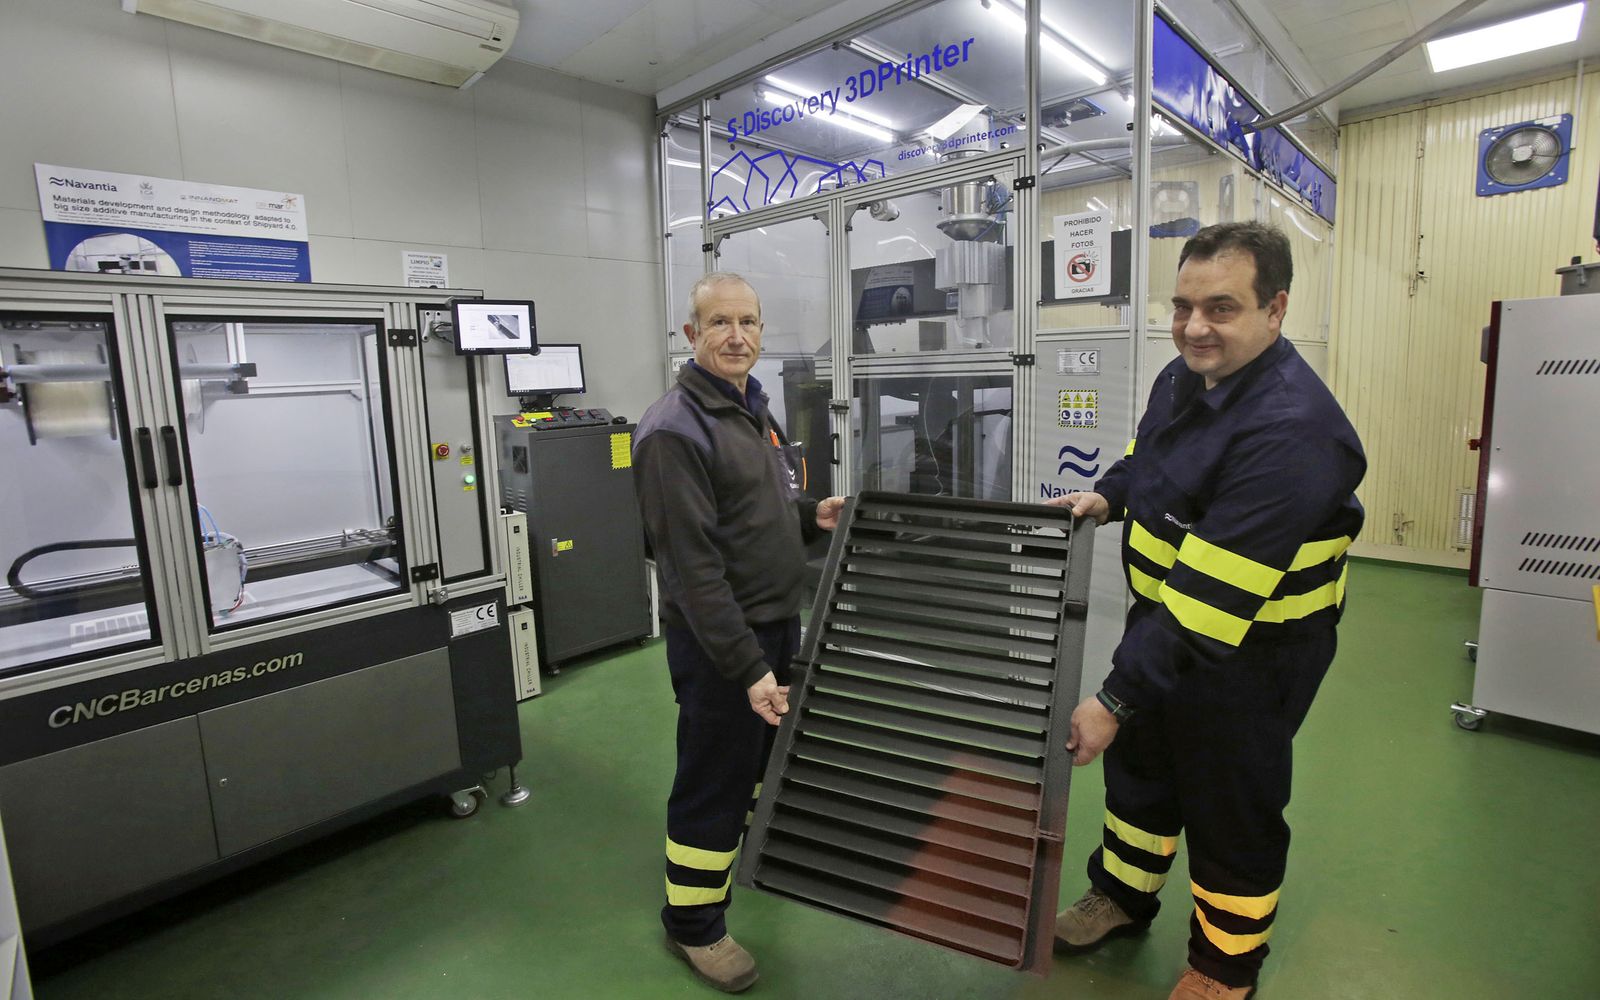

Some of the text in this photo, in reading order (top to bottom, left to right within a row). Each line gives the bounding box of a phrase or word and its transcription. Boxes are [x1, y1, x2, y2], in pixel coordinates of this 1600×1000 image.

[727, 38, 975, 143] S-Discovery 3DPrinter
[65, 178, 118, 192] Navantia
[53, 195, 96, 205] Materials
[98, 200, 154, 211] development
[173, 208, 200, 216] design
[202, 210, 250, 221] methodology
[254, 215, 282, 223] adapted
[54, 203, 69, 211] big
[71, 205, 90, 213] size
[93, 207, 127, 216] additive
[130, 210, 189, 222] manufacturing
[252, 220, 283, 230] Shipyard
[1063, 215, 1102, 227] PROHIBIDO
[1070, 228, 1094, 238] HACER
[1071, 240, 1094, 249] FOTOS
[476, 604, 495, 620] CE
[48, 651, 304, 729] CNCBarcenas.com
